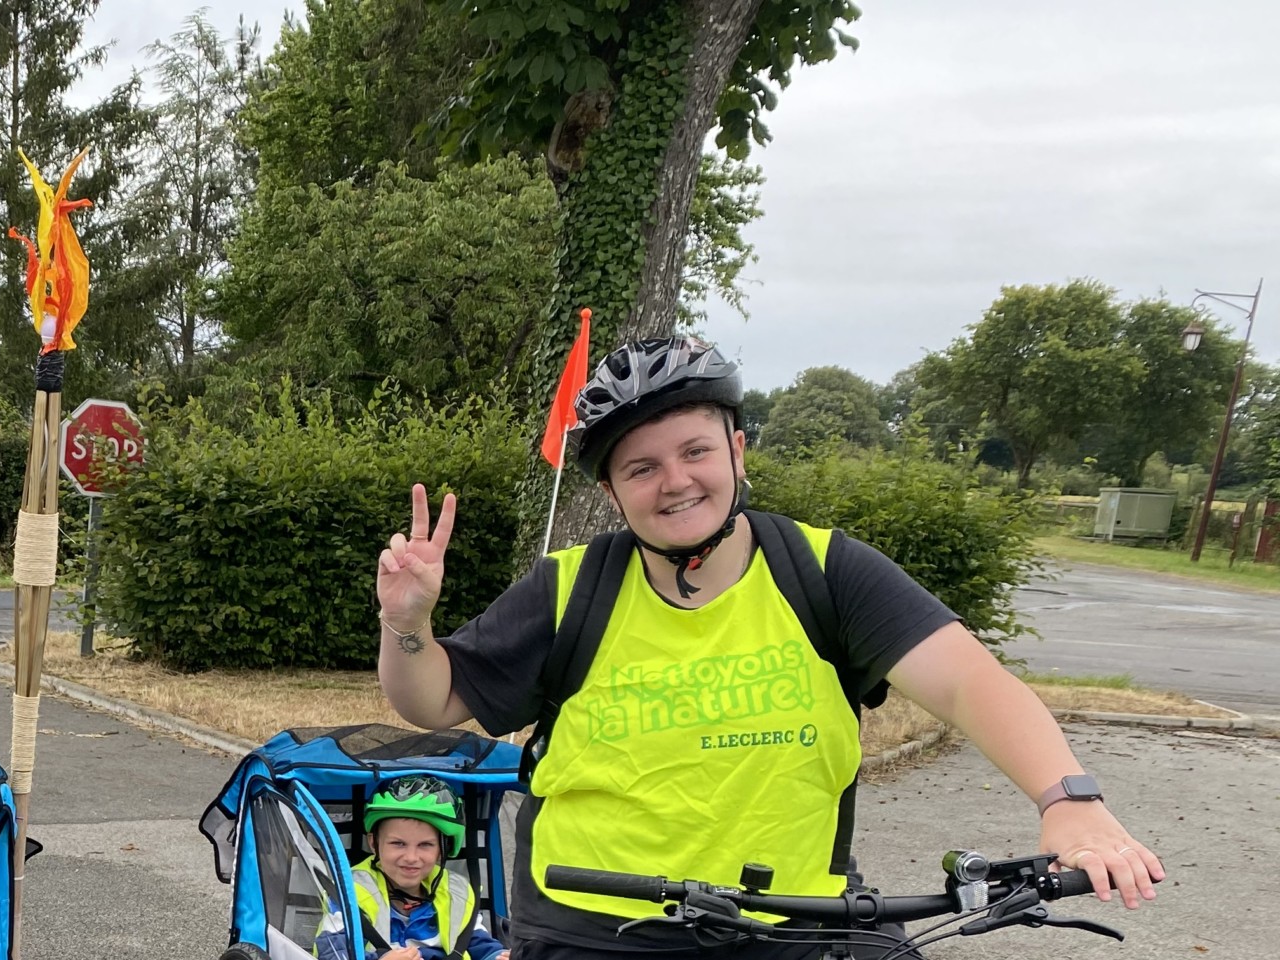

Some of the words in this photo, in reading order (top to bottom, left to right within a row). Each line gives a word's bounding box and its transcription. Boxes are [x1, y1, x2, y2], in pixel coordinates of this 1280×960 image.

[610, 640, 804, 698] Nettoyons
[586, 697, 629, 743] la
[640, 663, 815, 735] nature!
[701, 730, 795, 749] E.LECLERC
